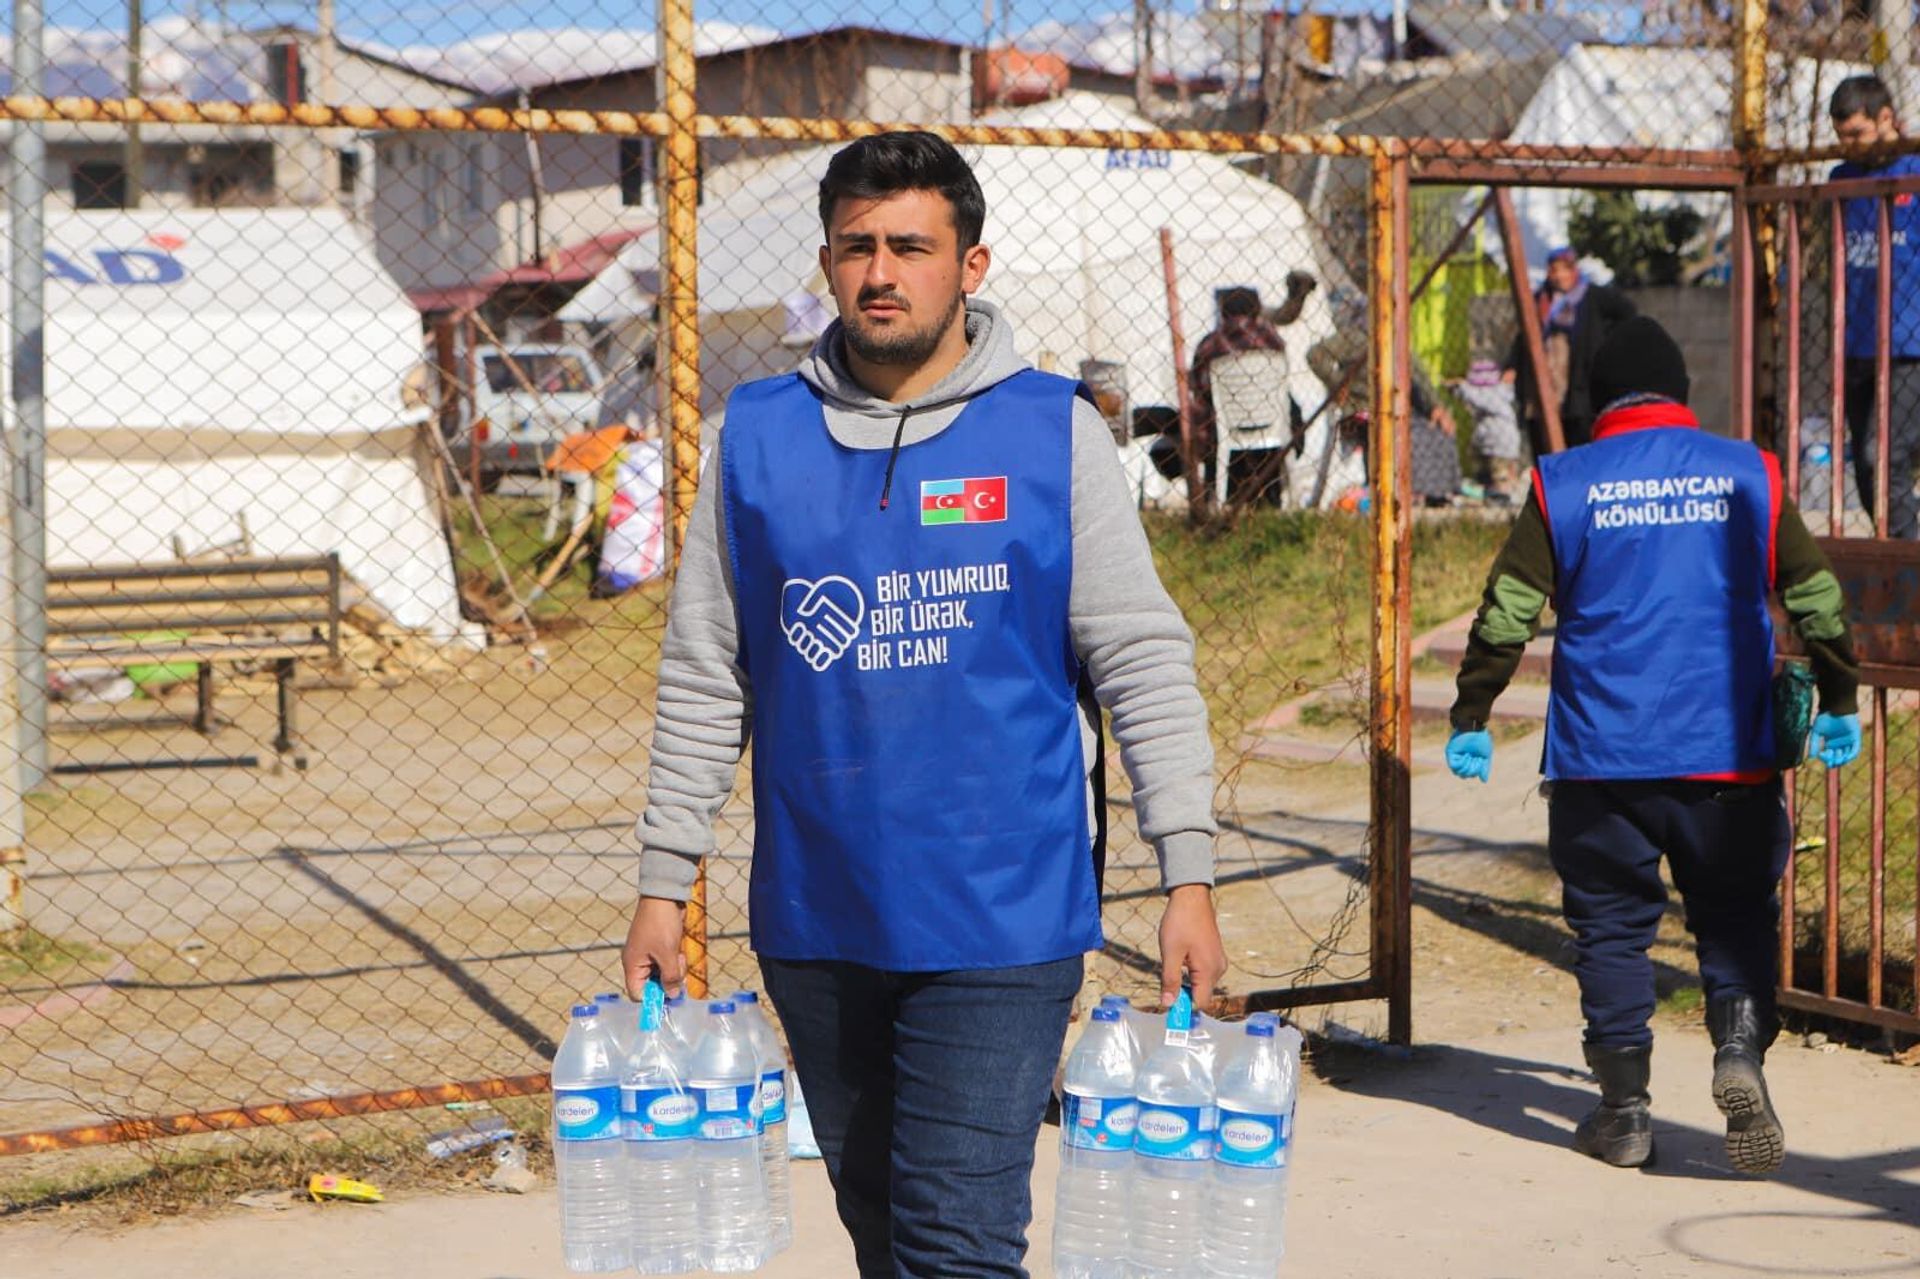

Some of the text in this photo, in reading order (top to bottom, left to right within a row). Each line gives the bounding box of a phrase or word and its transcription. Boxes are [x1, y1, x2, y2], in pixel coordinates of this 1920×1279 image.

[1587, 476, 1734, 505] AZƏRBAYCAN
[1595, 499, 1729, 529] KÖNÜLLÜSÜ
[877, 564, 1010, 603] BİR YUMRUQ,
[871, 604, 904, 636] BİR
[857, 636, 948, 671] BİR CAN!
